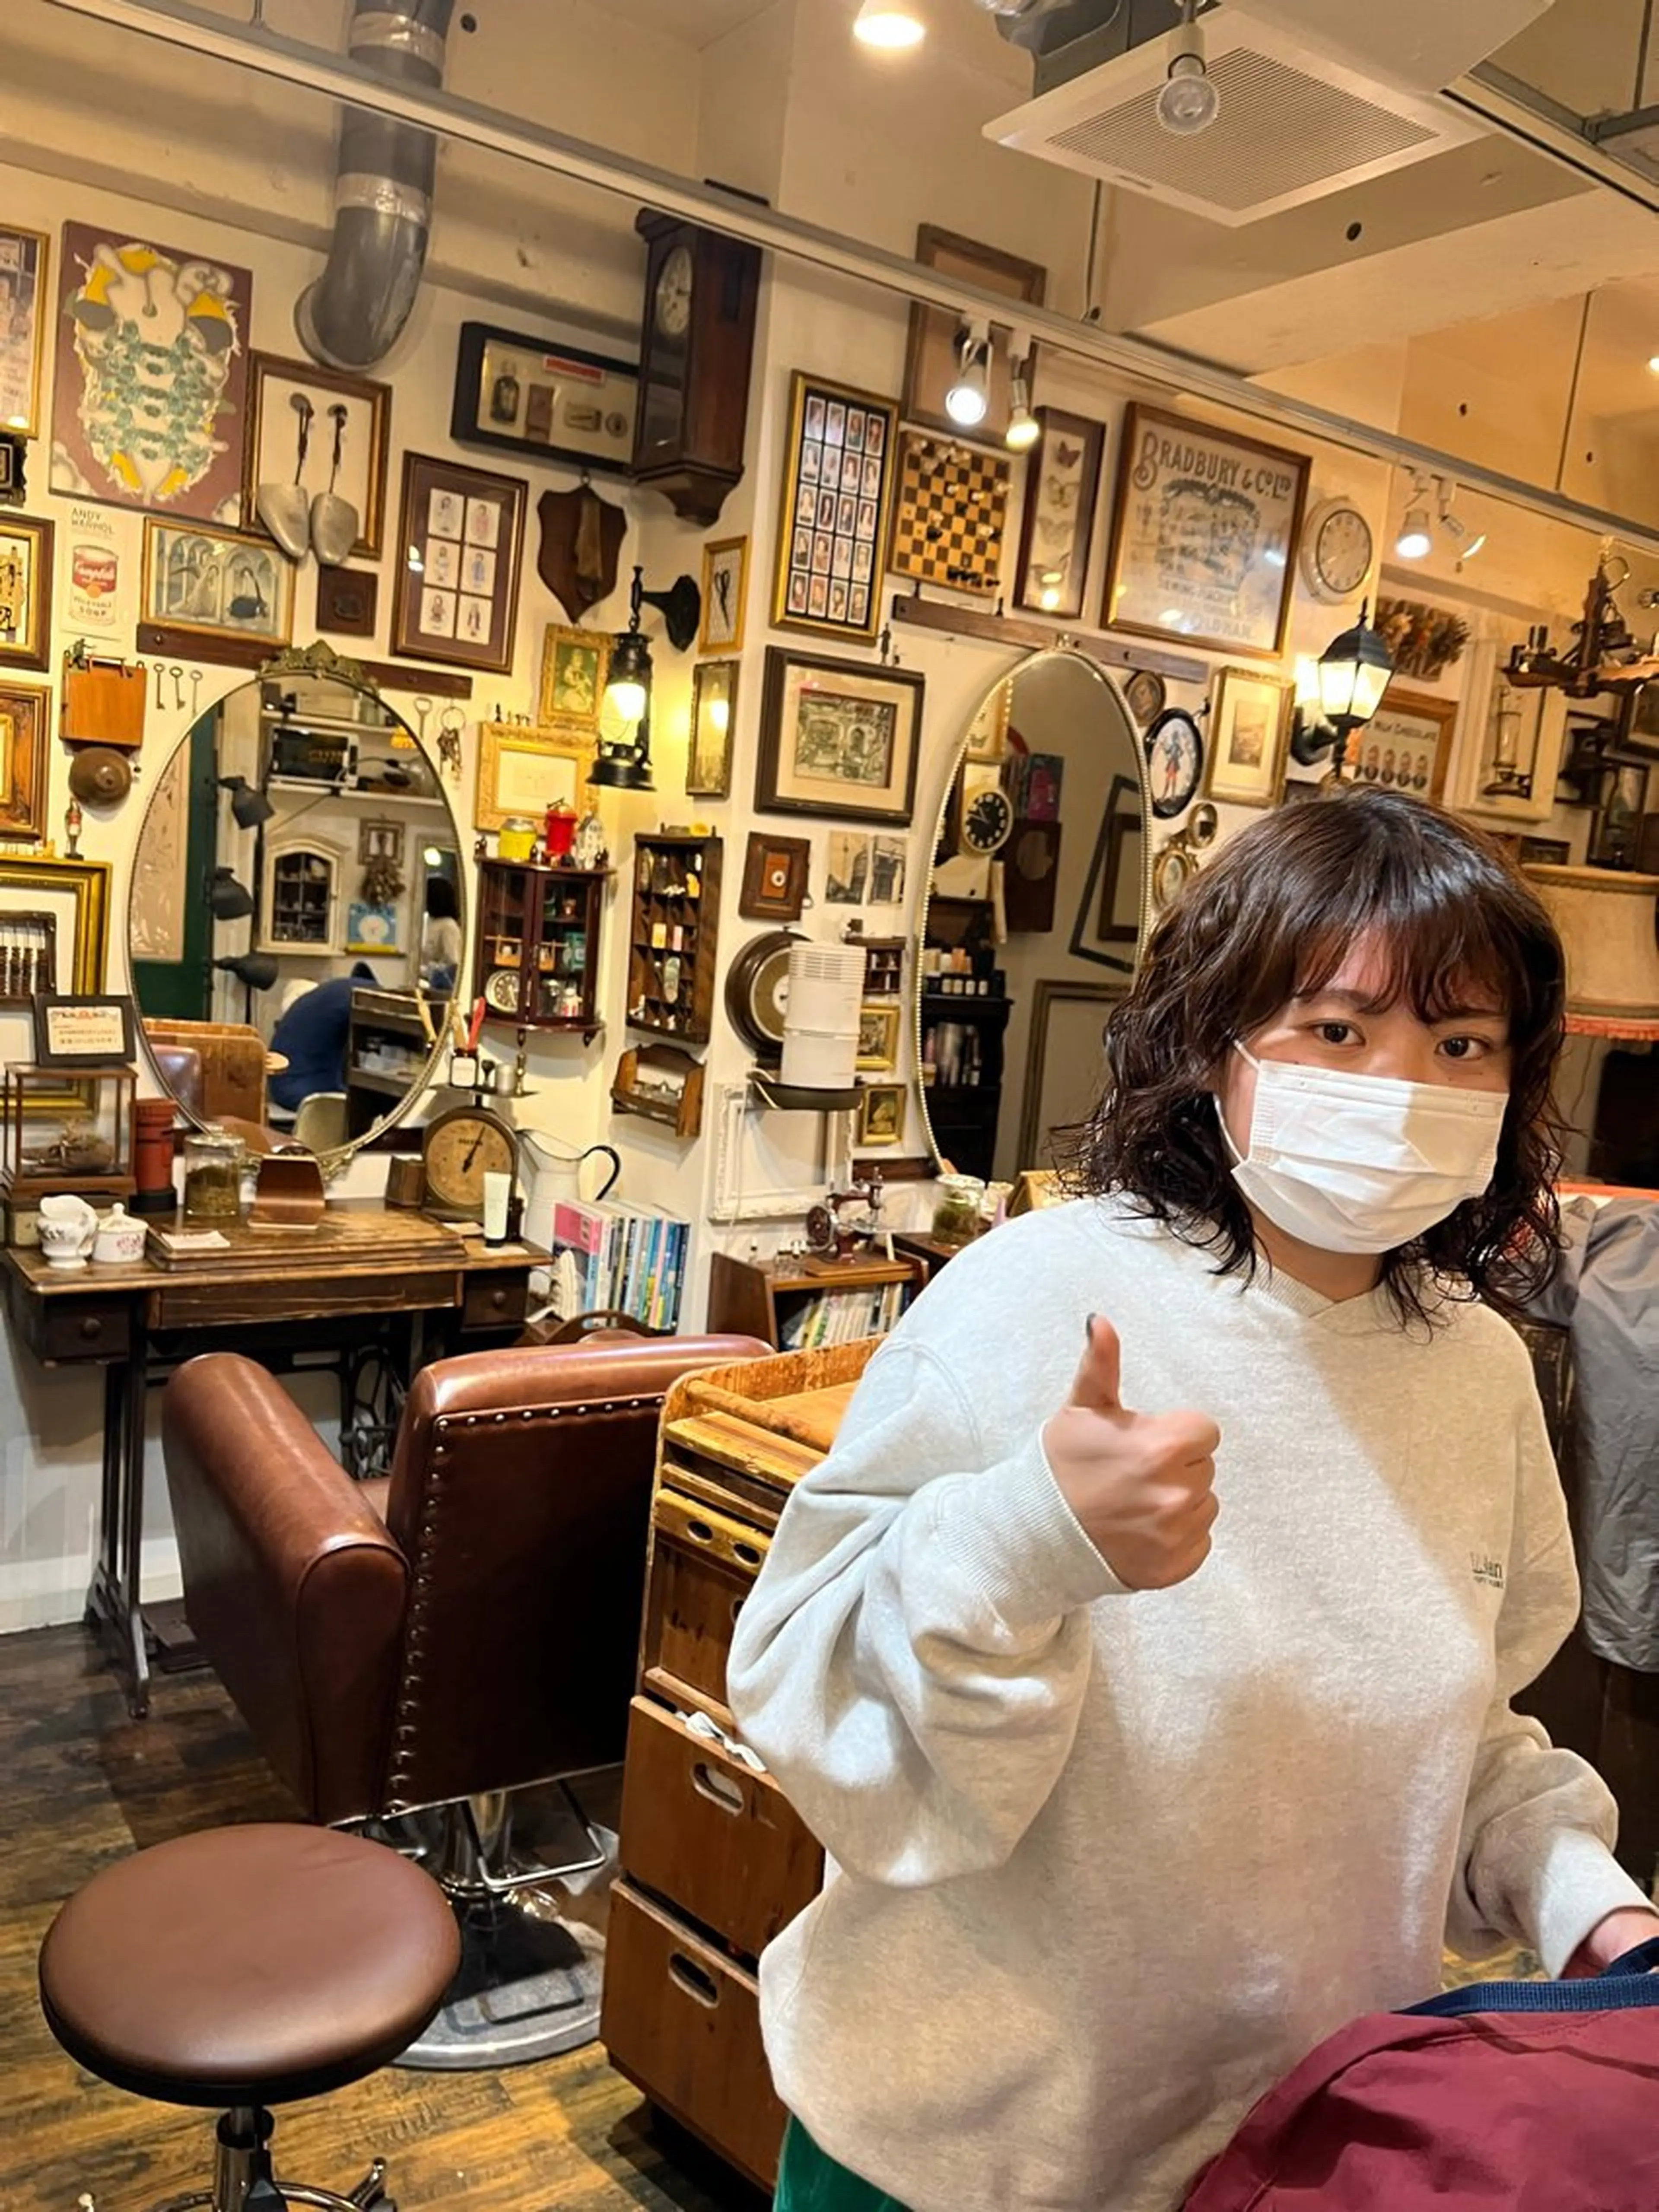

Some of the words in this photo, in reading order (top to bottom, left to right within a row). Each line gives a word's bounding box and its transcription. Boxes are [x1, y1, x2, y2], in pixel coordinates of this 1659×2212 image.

[1132, 431, 1242, 491] BRADBURY
[1241, 468, 1253, 491] &
[71, 507, 102, 521] ANDY
